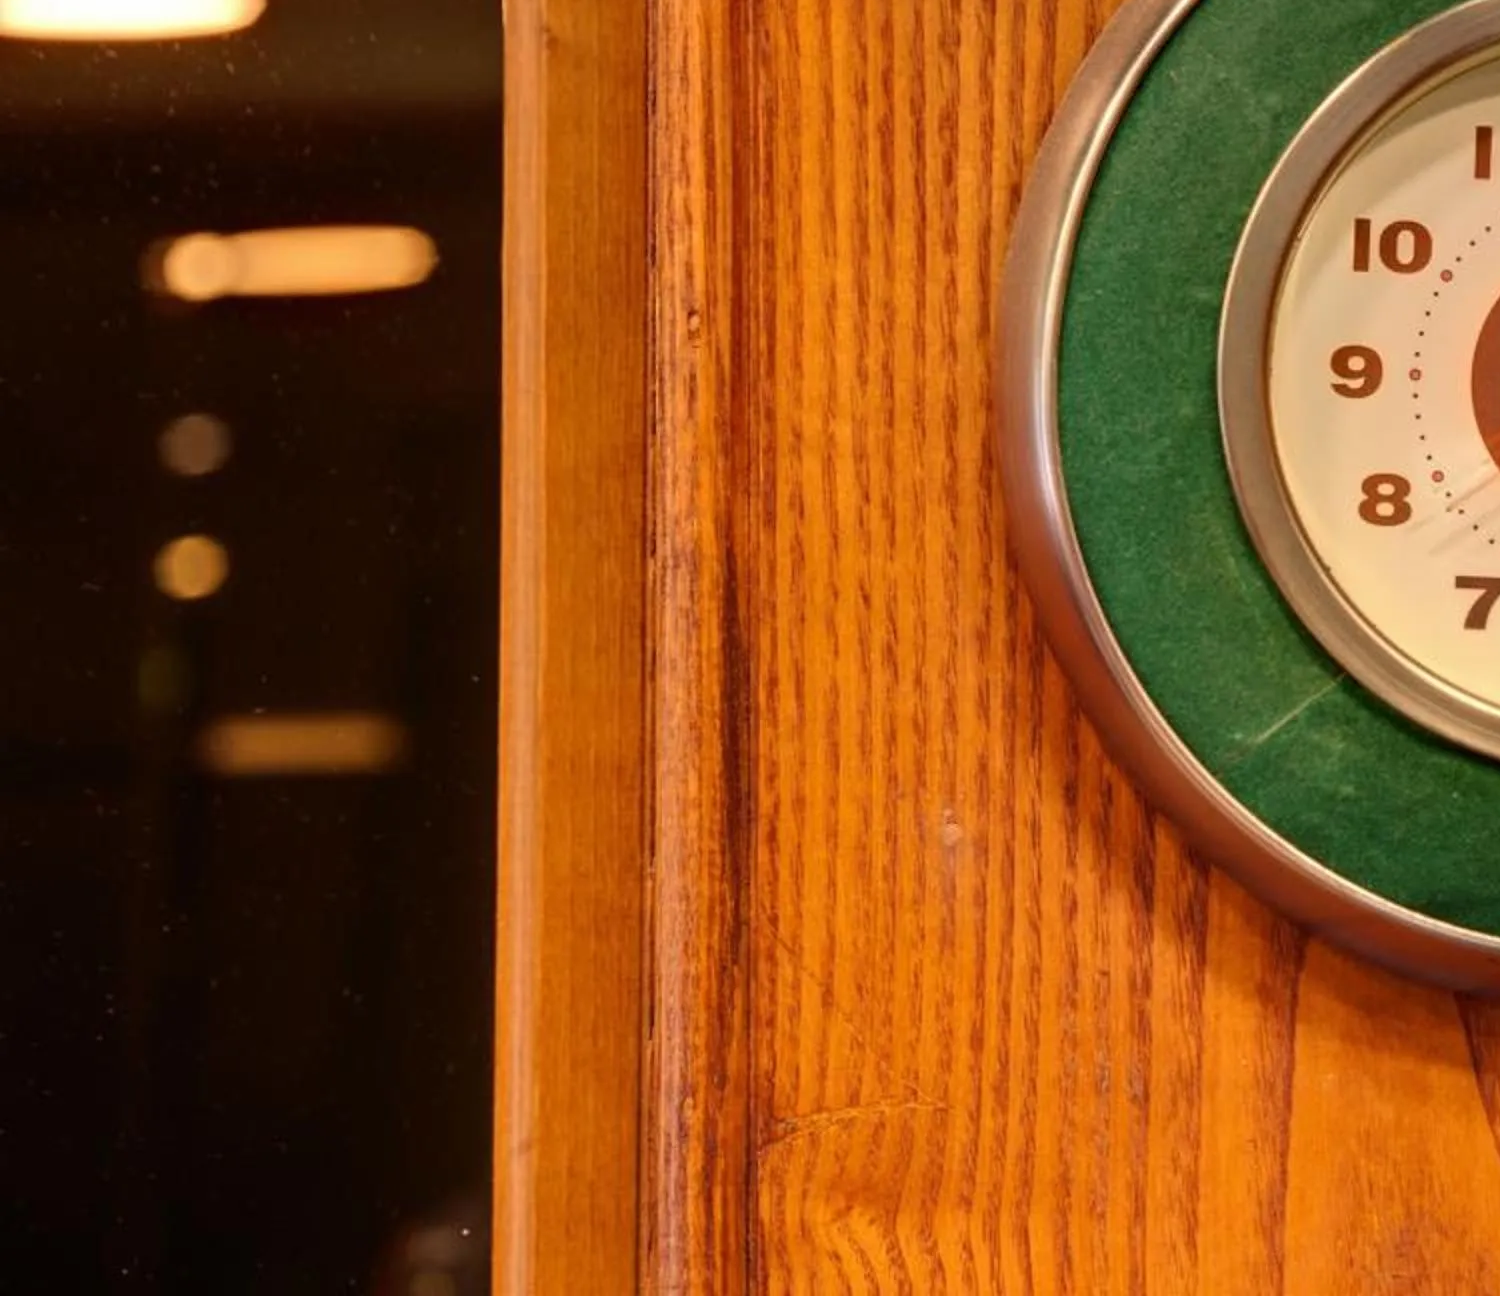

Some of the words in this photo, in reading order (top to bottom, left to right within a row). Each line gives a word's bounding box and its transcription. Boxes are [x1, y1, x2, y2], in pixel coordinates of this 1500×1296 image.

[1352, 217, 1433, 275] 10
[1329, 344, 1384, 399] 9
[1358, 473, 1412, 527] 8
